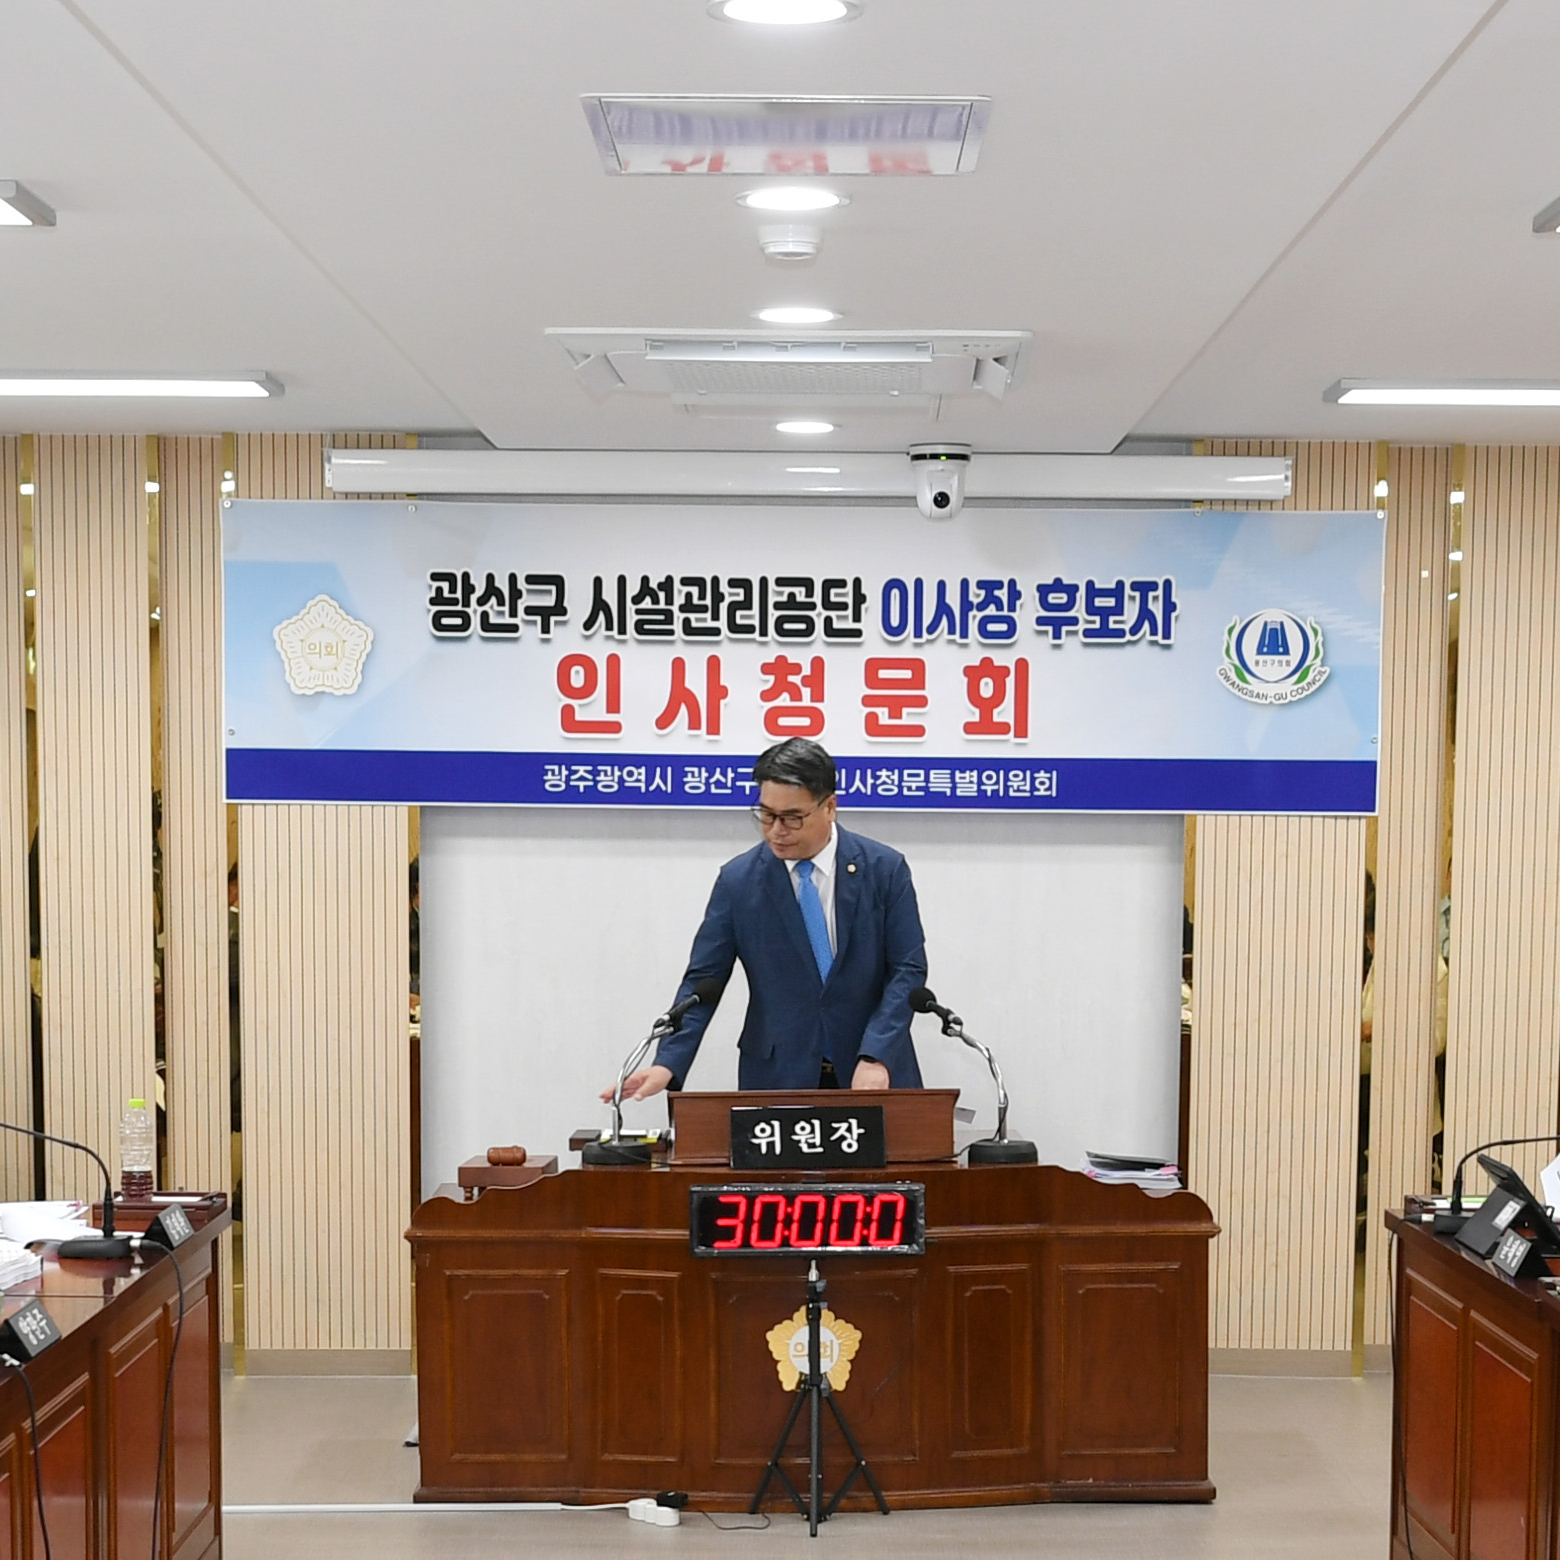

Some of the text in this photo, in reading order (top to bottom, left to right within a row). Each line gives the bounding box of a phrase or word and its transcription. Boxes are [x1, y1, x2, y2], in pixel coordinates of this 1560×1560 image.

[428, 570, 1178, 642] 광산구 시설관리공단 이사장 후보자
[307, 640, 339, 660] 의회
[556, 652, 1030, 739] 인사청문회
[1218, 667, 1329, 701] GWANGSAN-GU COUNCIL
[542, 763, 673, 792] 광주광역시
[683, 766, 758, 796] 광산구
[750, 1118, 865, 1156] 위원장
